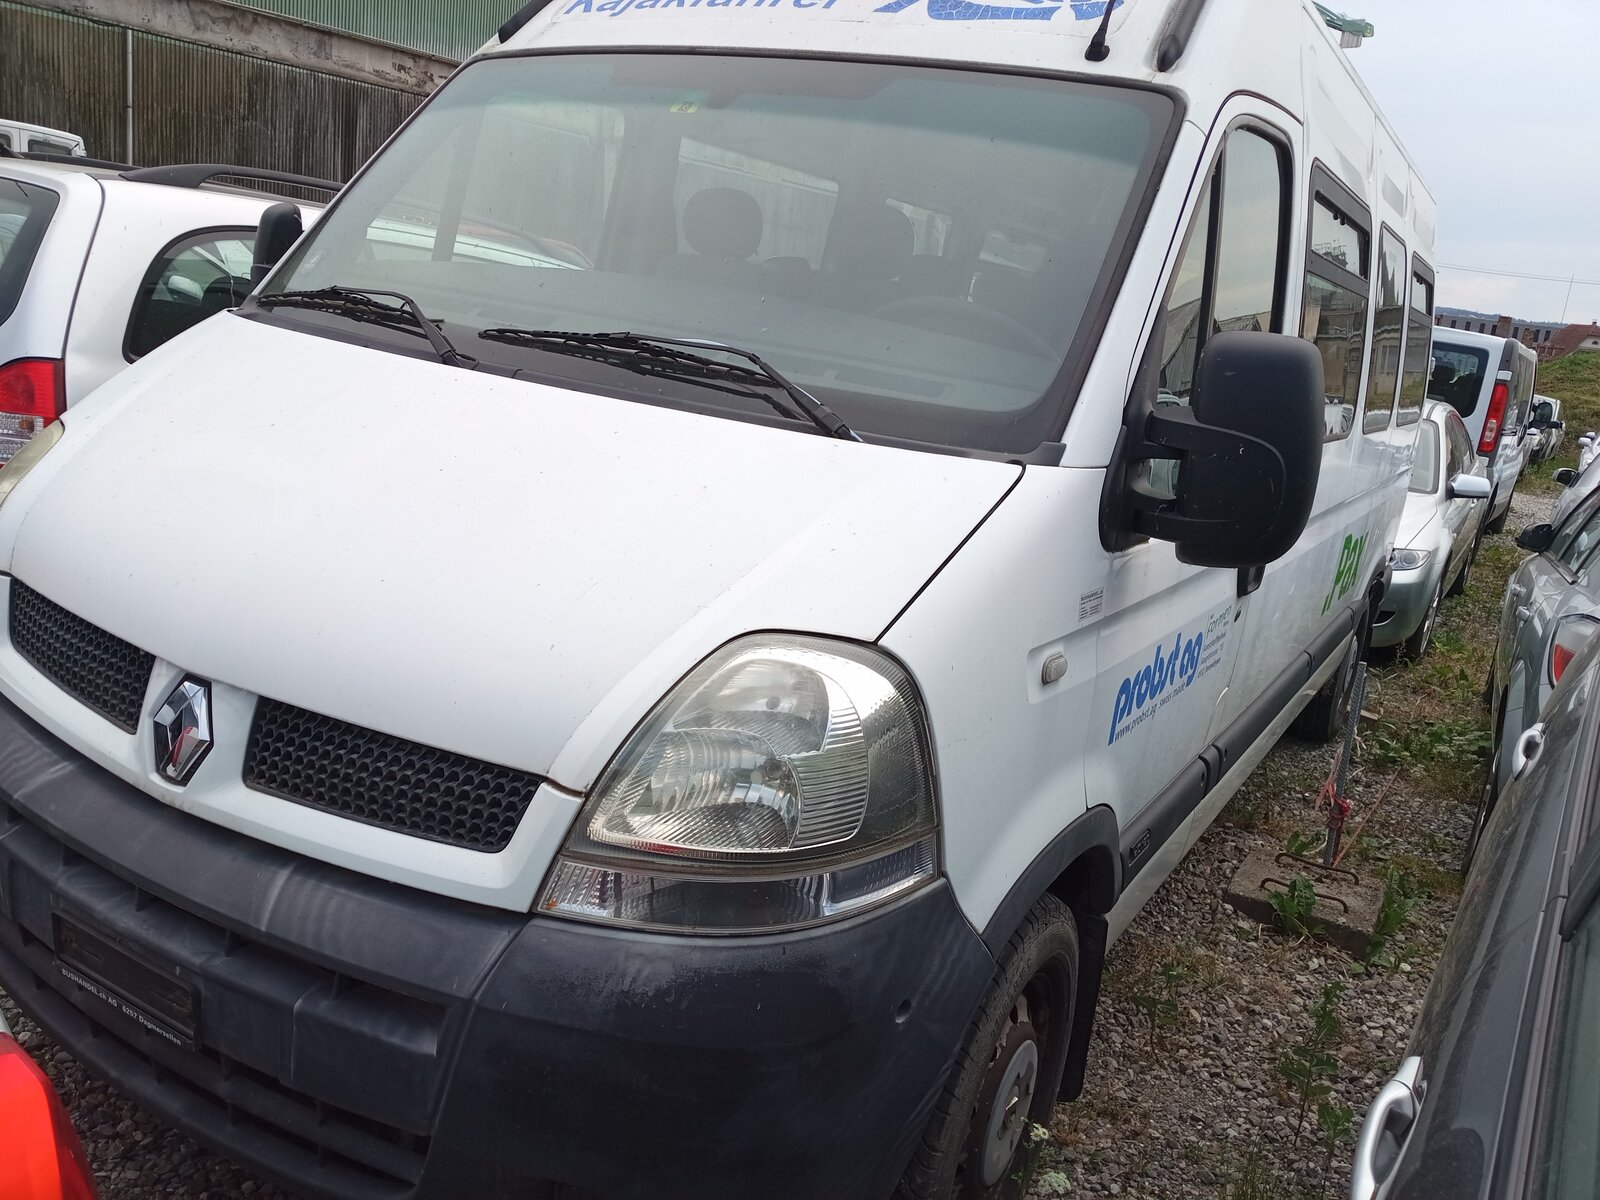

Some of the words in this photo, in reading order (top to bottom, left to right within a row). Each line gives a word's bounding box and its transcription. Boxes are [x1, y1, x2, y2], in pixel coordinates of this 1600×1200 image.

[1108, 632, 1181, 746] probst
[1178, 631, 1203, 689] ag
[1114, 703, 1157, 742] www.probst.ag
[61, 968, 107, 1000] BUSHANDEL.ch
[108, 997, 117, 1008] AG
[139, 1015, 181, 1046] Dagmersellen
